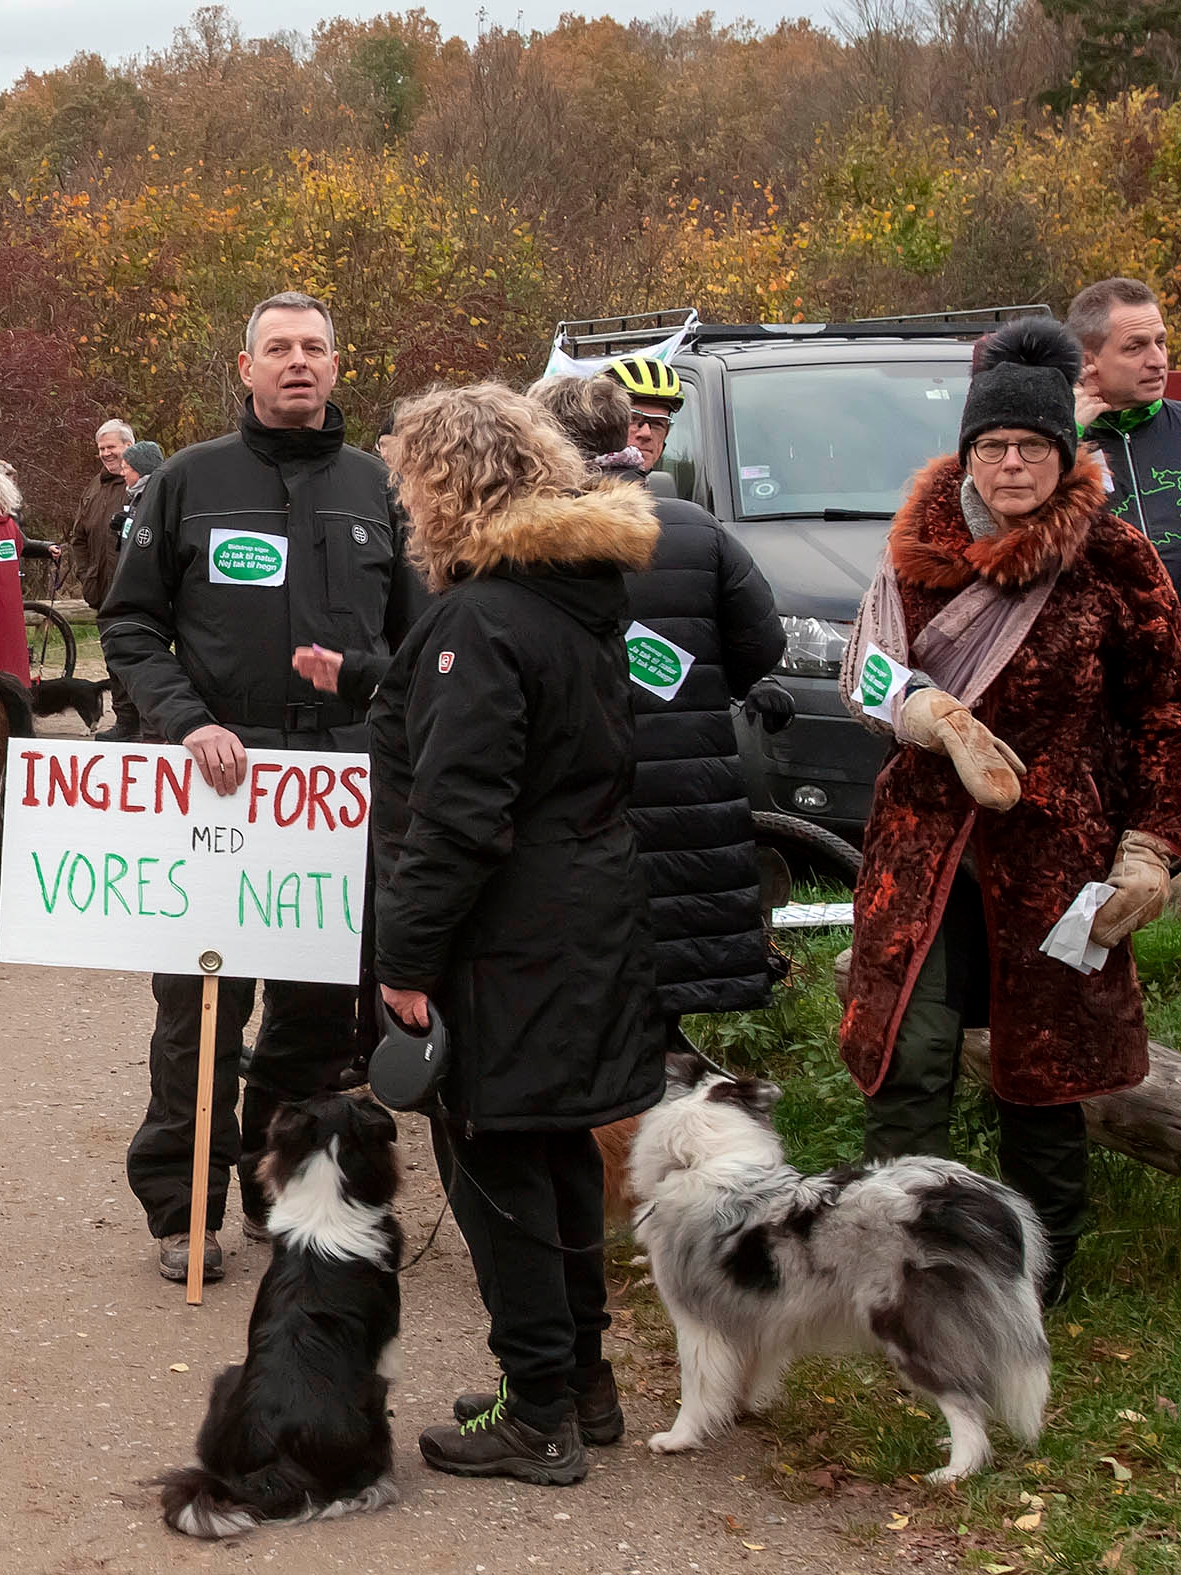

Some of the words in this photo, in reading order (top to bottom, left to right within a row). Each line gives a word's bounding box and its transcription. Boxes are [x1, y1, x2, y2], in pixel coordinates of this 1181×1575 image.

[20, 751, 193, 817] INGEN
[247, 762, 369, 832] FORS
[191, 825, 245, 854] MED
[30, 849, 189, 919] VORES
